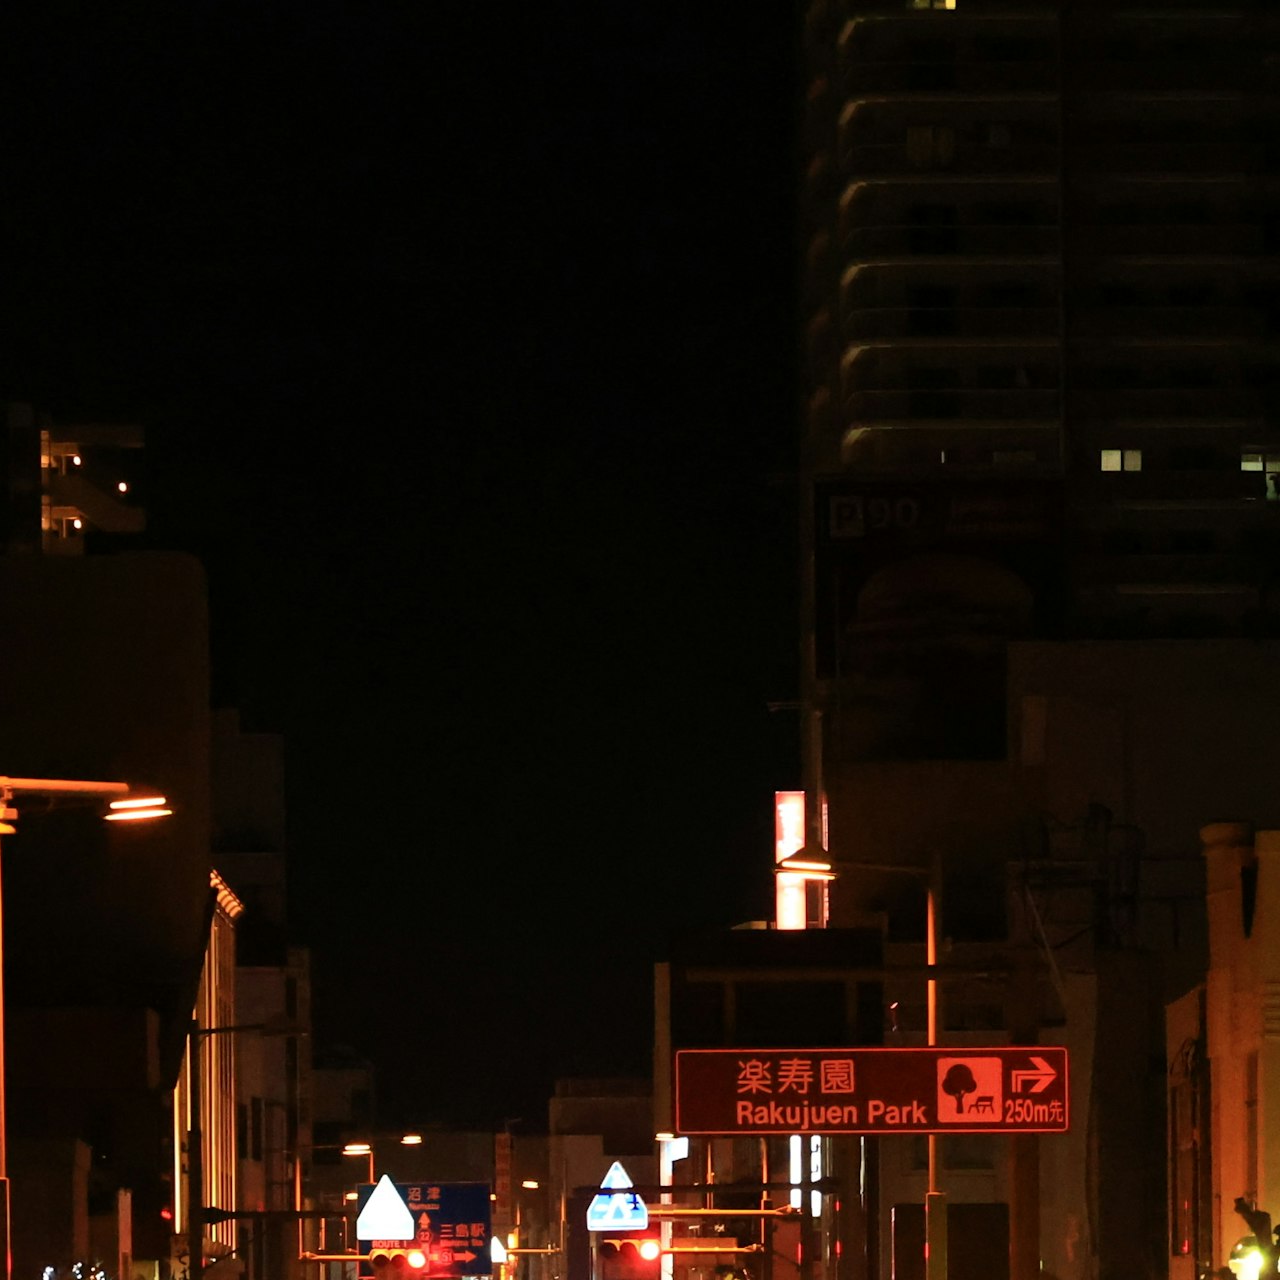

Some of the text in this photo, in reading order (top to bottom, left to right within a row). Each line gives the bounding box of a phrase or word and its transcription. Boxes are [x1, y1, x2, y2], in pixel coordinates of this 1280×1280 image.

[736, 1058, 856, 1095] 楽寿園
[736, 1099, 928, 1130] Rakujuen Park
[1004, 1098, 1064, 1124] 250m先
